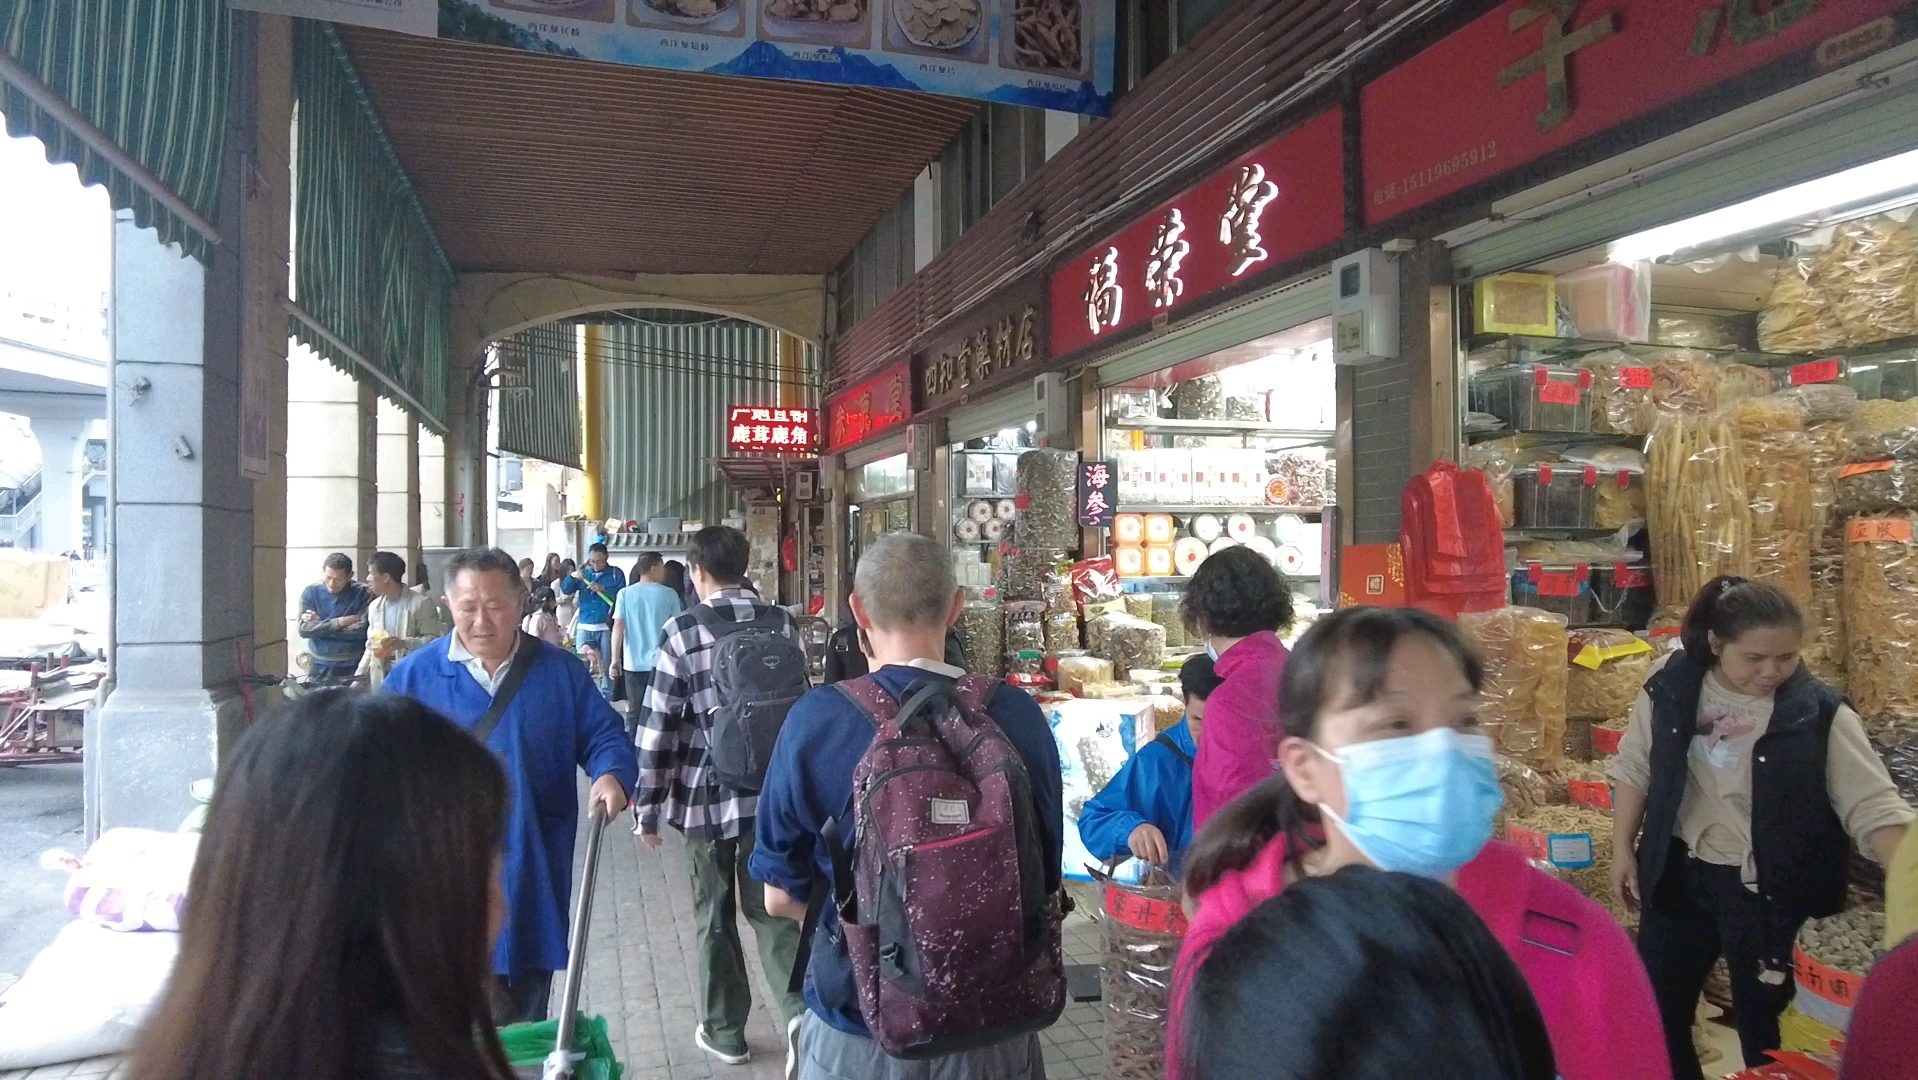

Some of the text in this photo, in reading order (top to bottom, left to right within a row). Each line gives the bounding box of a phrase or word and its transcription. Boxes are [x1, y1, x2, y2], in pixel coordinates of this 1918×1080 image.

[731, 423, 808, 445] 鹿茸鹿角
[1085, 463, 1111, 516] 海参
